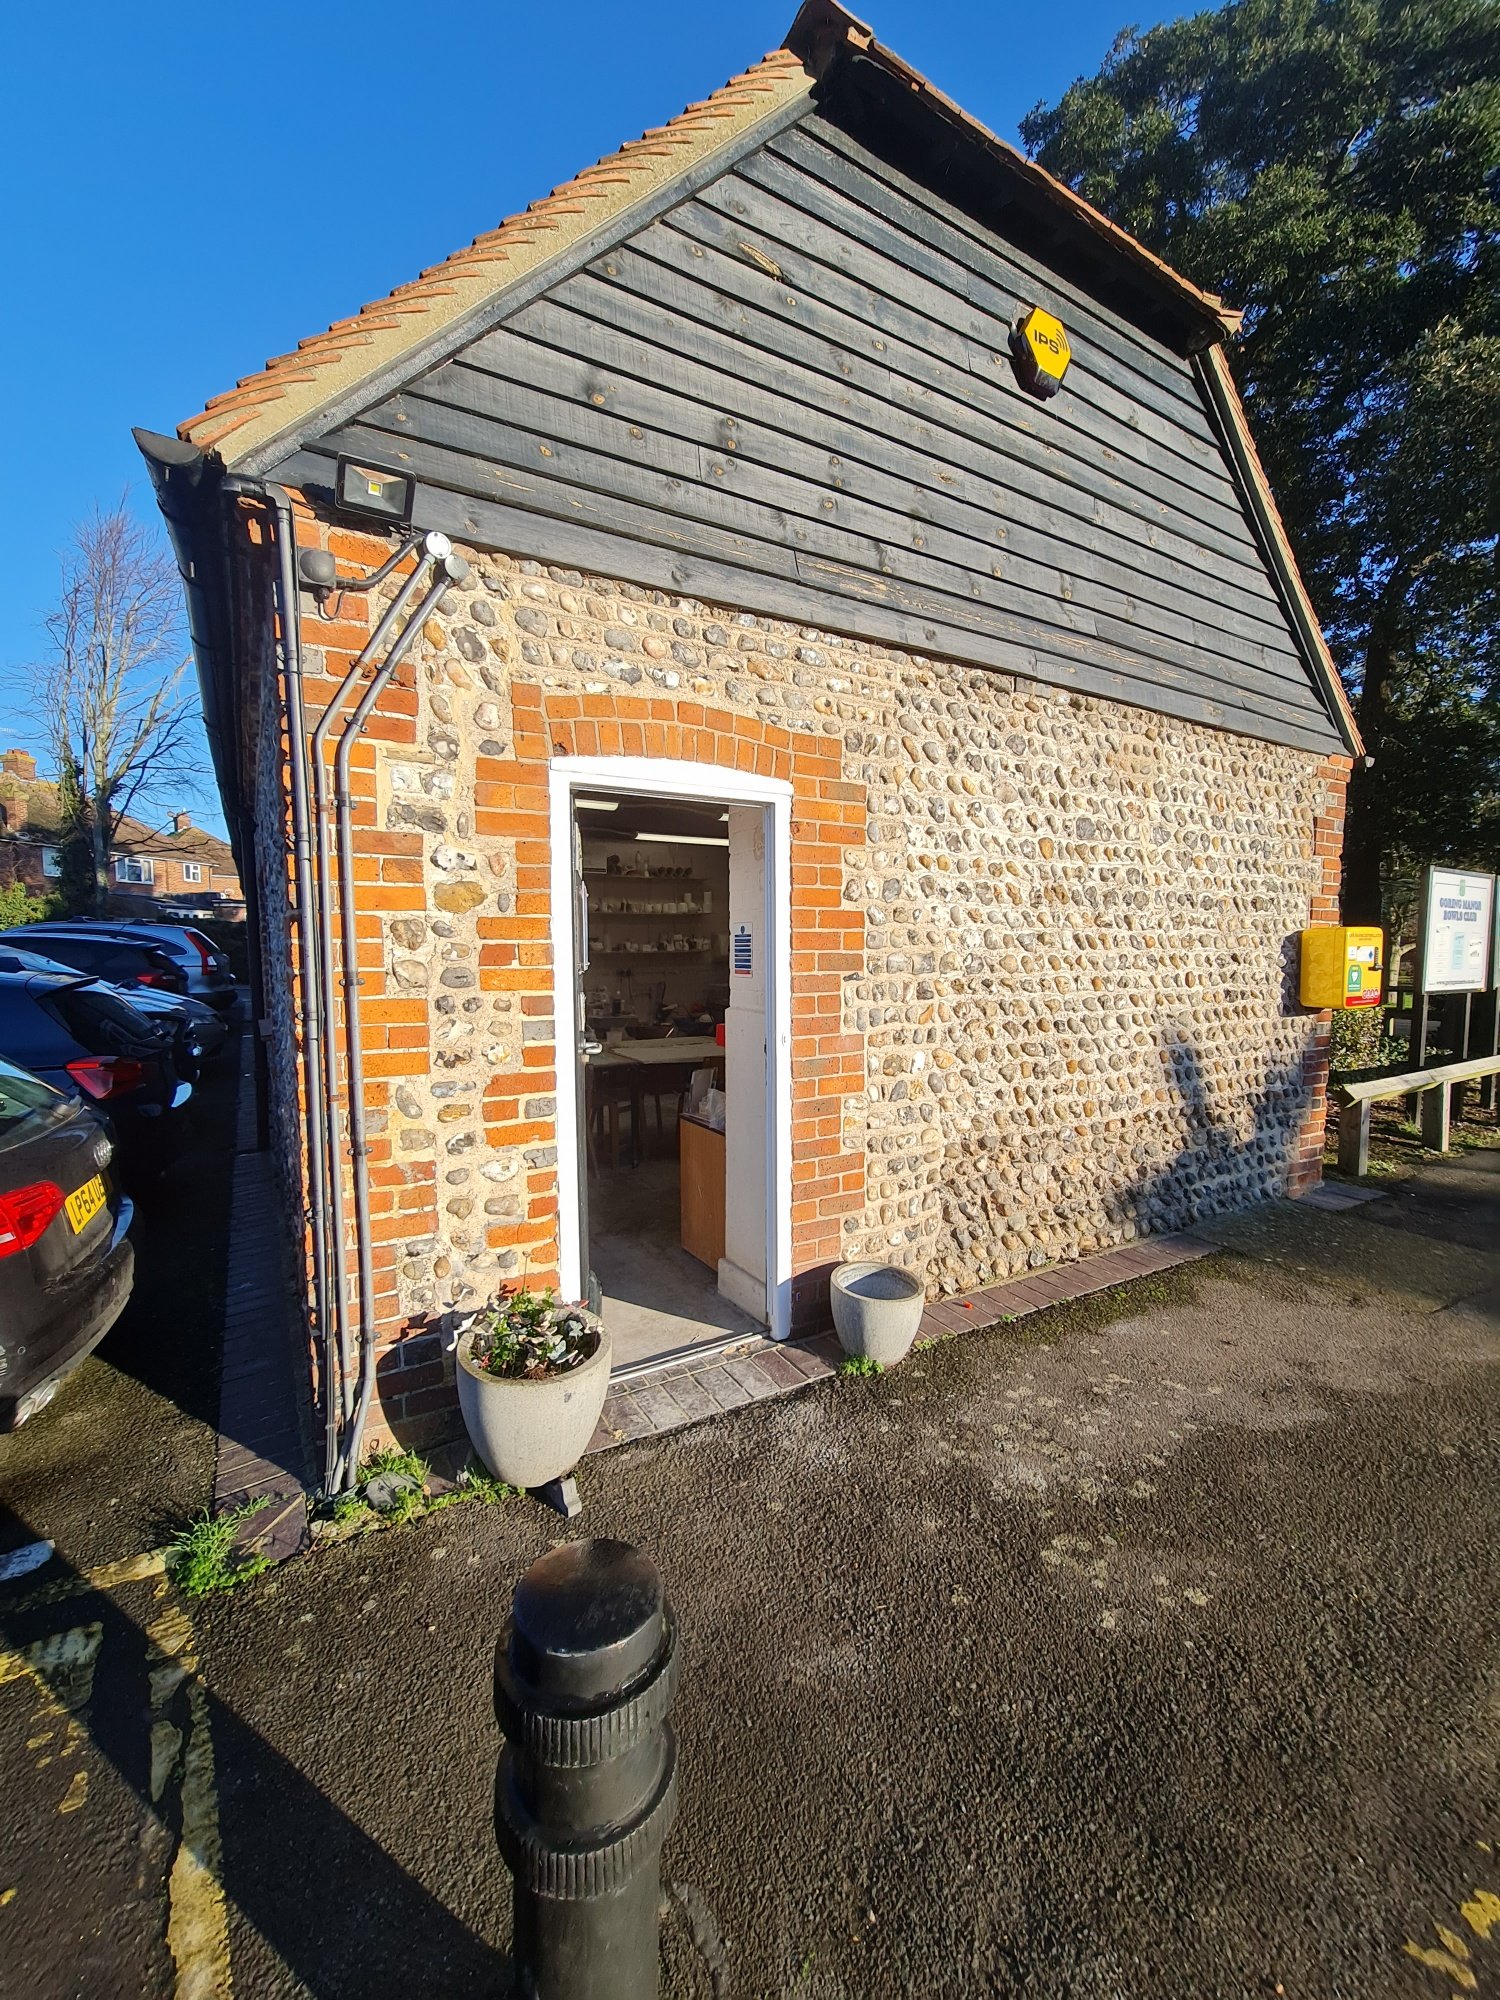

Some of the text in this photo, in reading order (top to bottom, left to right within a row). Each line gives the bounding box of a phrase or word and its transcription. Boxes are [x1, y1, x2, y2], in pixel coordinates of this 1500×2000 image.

[1034, 329, 1060, 355] IPS
[1443, 910, 1477, 922] BOWLS CLUB
